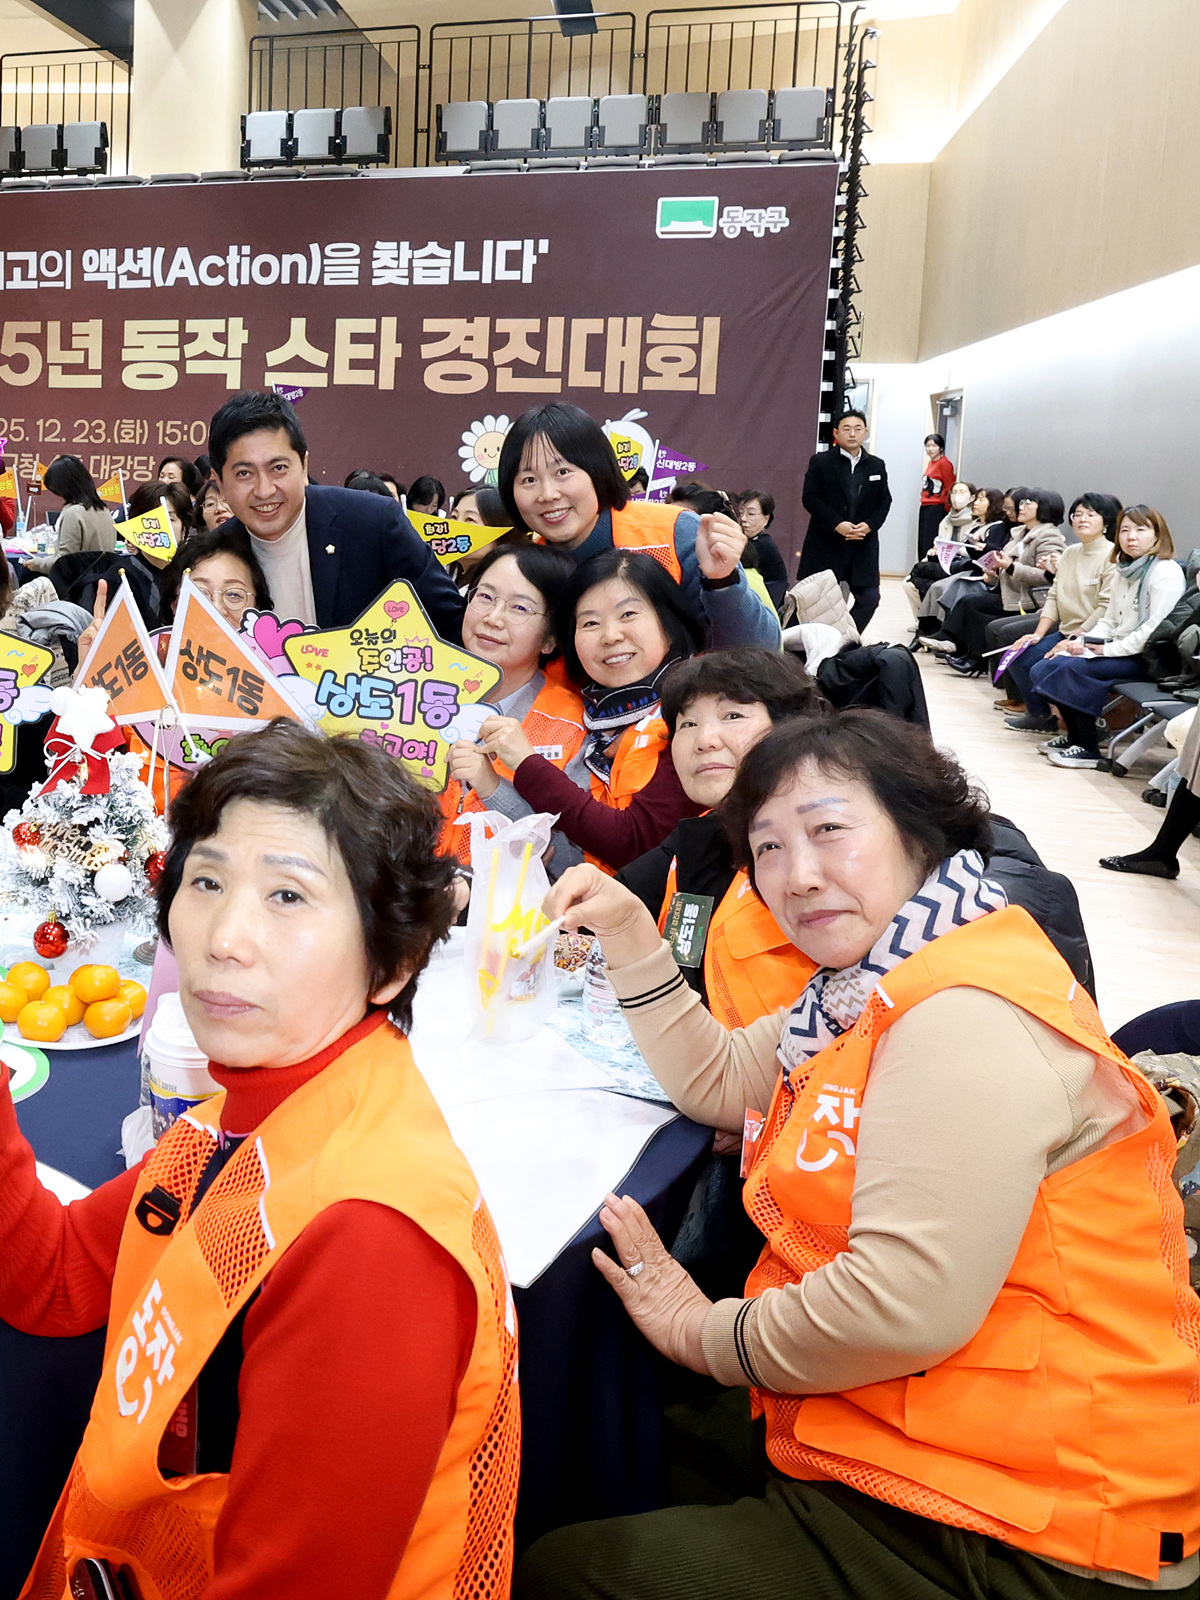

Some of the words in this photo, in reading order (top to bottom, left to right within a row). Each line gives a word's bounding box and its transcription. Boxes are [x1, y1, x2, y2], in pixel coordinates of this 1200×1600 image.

[721, 207, 788, 237] 동작구
[81, 242, 361, 290] 액션(Action)을
[120, 316, 249, 391] 동작
[264, 315, 403, 391] 스타
[420, 312, 722, 395] 경진대회
[36, 418, 67, 443] 12.
[71, 418, 149, 445] 23.(화)
[155, 419, 210, 446] 15:0
[89, 455, 156, 482] 대강당
[617, 453, 639, 472] 당2동
[655, 458, 697, 473] 신대방2동
[427, 535, 472, 555] 당2동
[387, 605, 406, 613] LOVE
[300, 643, 330, 658] LOVE
[350, 627, 397, 647] 오늘의
[84, 639, 149, 700] 도1동
[357, 645, 435, 674] 주인공!
[179, 639, 266, 717] 상도1동
[314, 669, 461, 730] 상도1동
[676, 903, 700, 956] 상도1동
